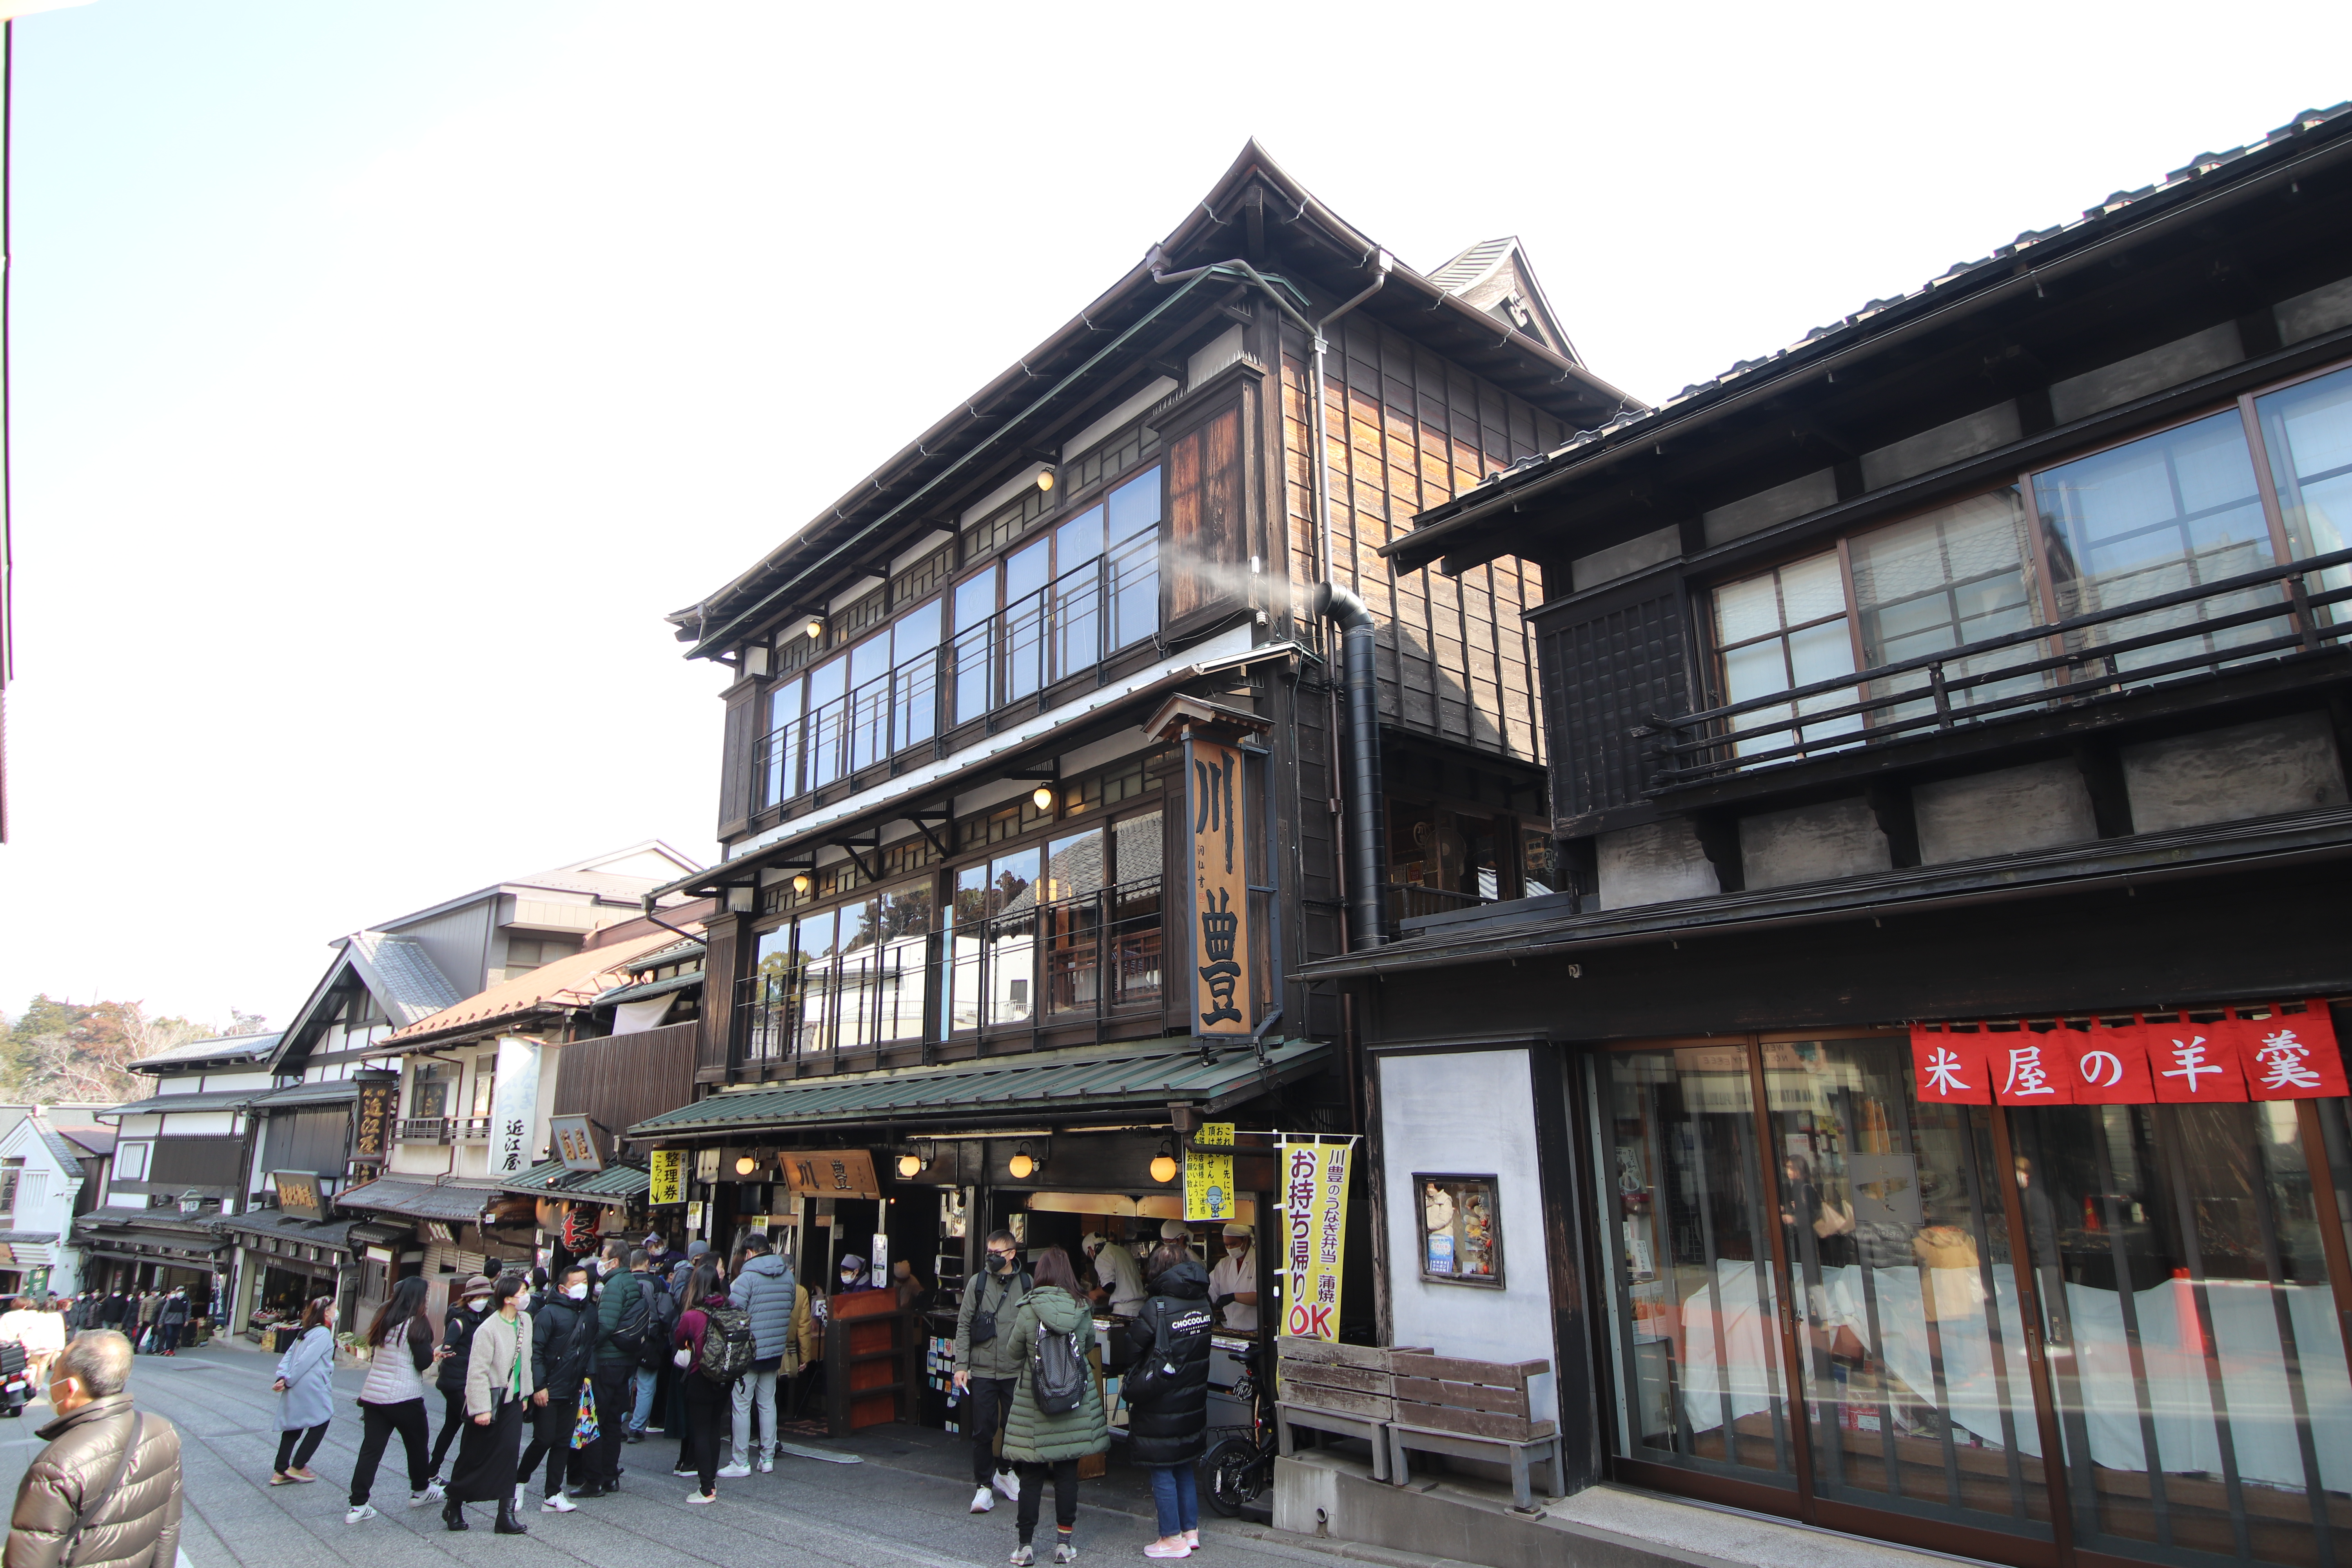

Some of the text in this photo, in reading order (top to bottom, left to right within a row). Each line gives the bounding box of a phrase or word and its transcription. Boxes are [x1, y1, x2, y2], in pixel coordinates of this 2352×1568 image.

[1194, 748, 1242, 1027] 川豊
[1924, 1029, 2321, 1096] 米屋の羊羹
[358, 1098, 385, 1155] 近江屋
[501, 1119, 524, 1171] 近江屋
[664, 1152, 679, 1200] 整理券
[796, 1159, 852, 1190] 川豊
[1223, 1127, 1232, 1206] これり先には、
[1318, 1149, 1345, 1303] 川豊のうなぎ弁当・蒲焼
[1172, 1314, 1211, 1329] CHOCOOLATE
